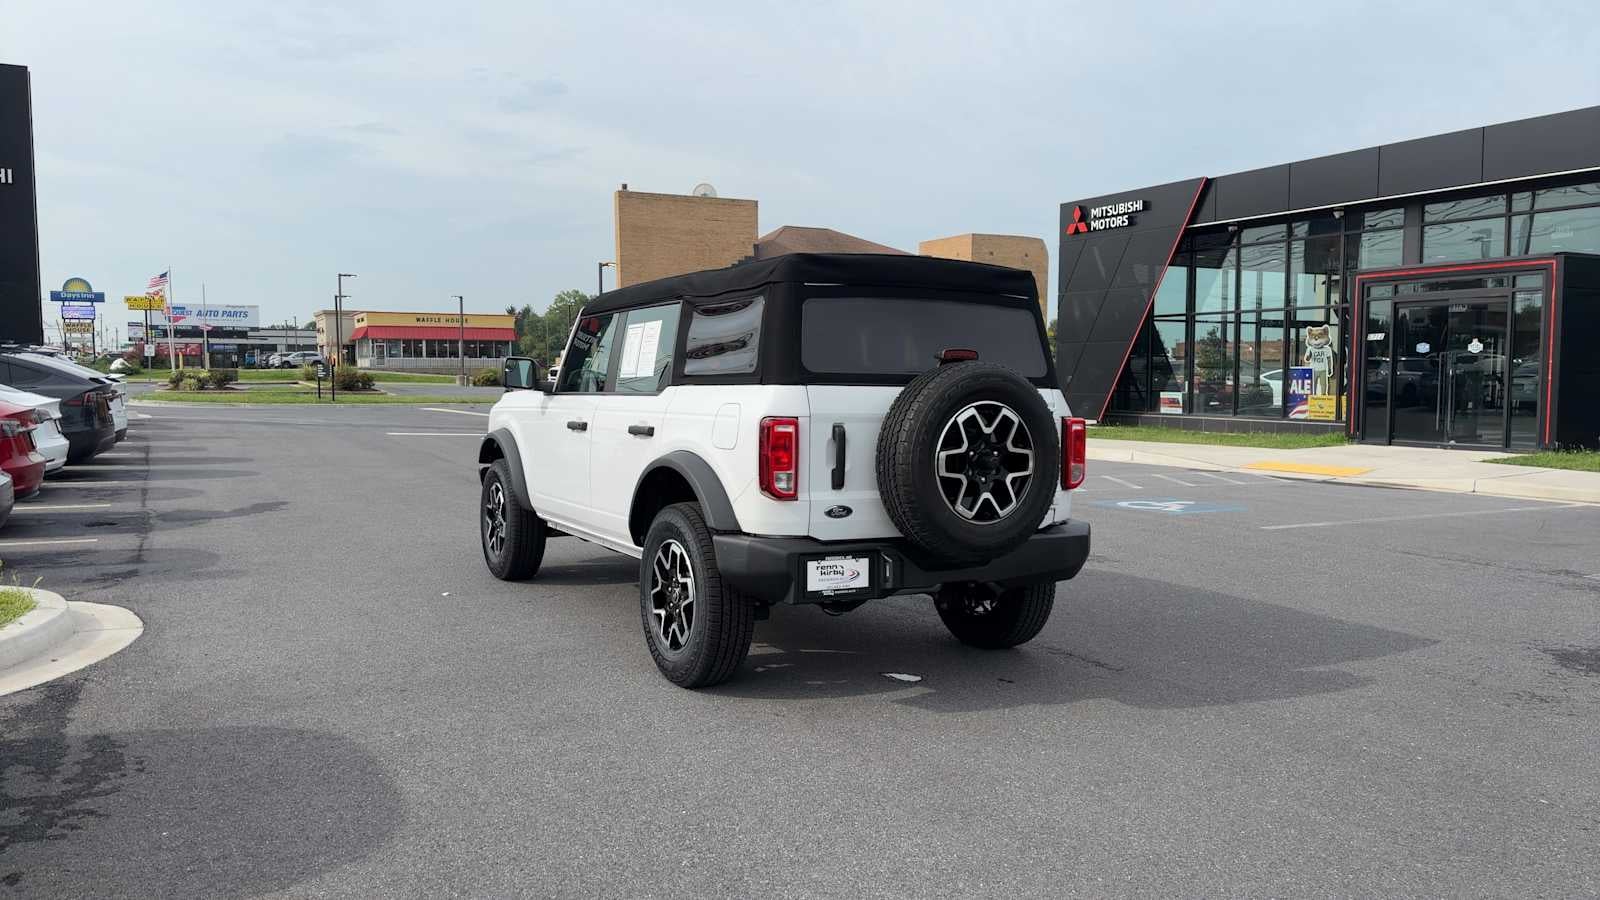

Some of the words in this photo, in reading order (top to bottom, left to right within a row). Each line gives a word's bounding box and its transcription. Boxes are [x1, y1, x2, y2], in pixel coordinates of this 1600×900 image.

[1090, 199, 1143, 219] MITSUBISHI
[1090, 214, 1129, 231] MOTORS
[196, 309, 219, 318] AUTO
[221, 310, 249, 319] PARTS
[1289, 379, 1312, 395] ALE
